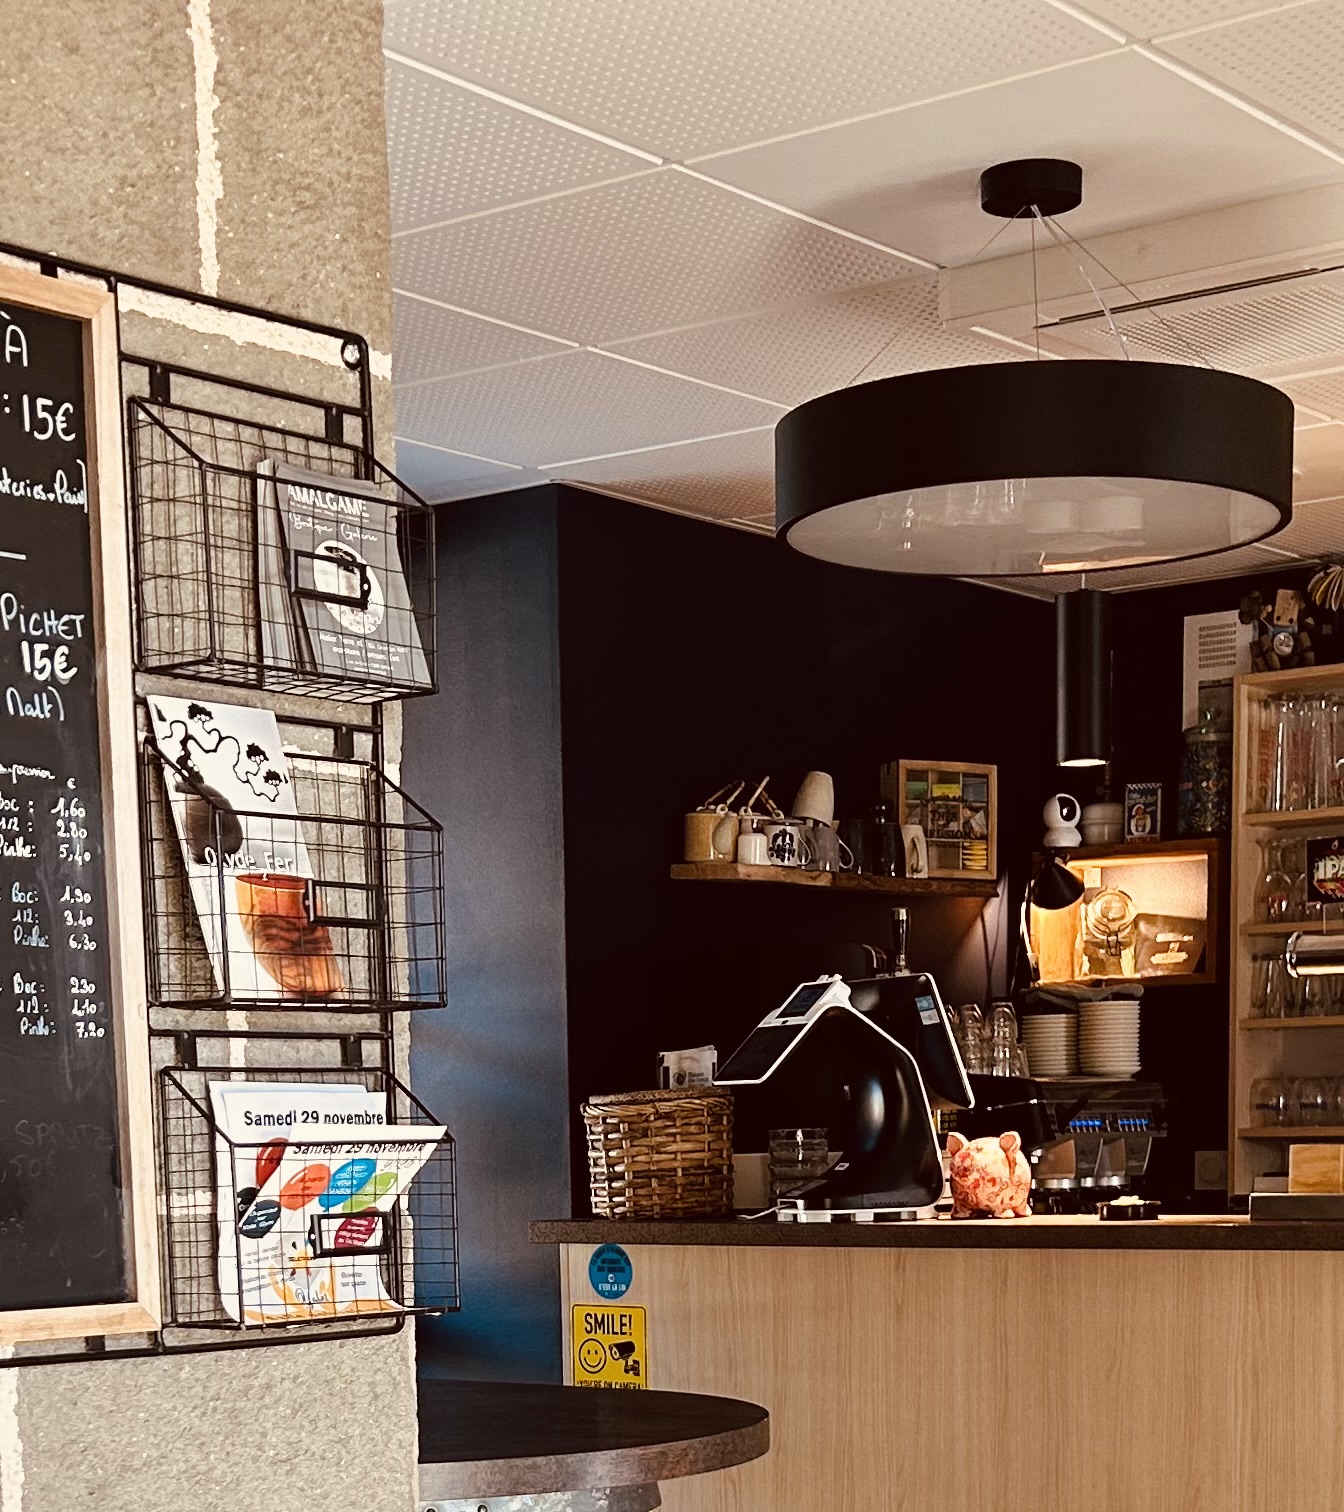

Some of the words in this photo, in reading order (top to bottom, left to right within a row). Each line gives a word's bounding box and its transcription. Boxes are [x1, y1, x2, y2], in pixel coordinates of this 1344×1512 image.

[0, 310, 28, 367] À
[22, 394, 76, 441] 15€
[20, 640, 78, 681] 15€
[205, 847, 256, 869] Oyde
[302, 1110, 320, 1124] 29
[323, 1110, 384, 1125] novembre
[584, 1312, 632, 1336] SMILE!
